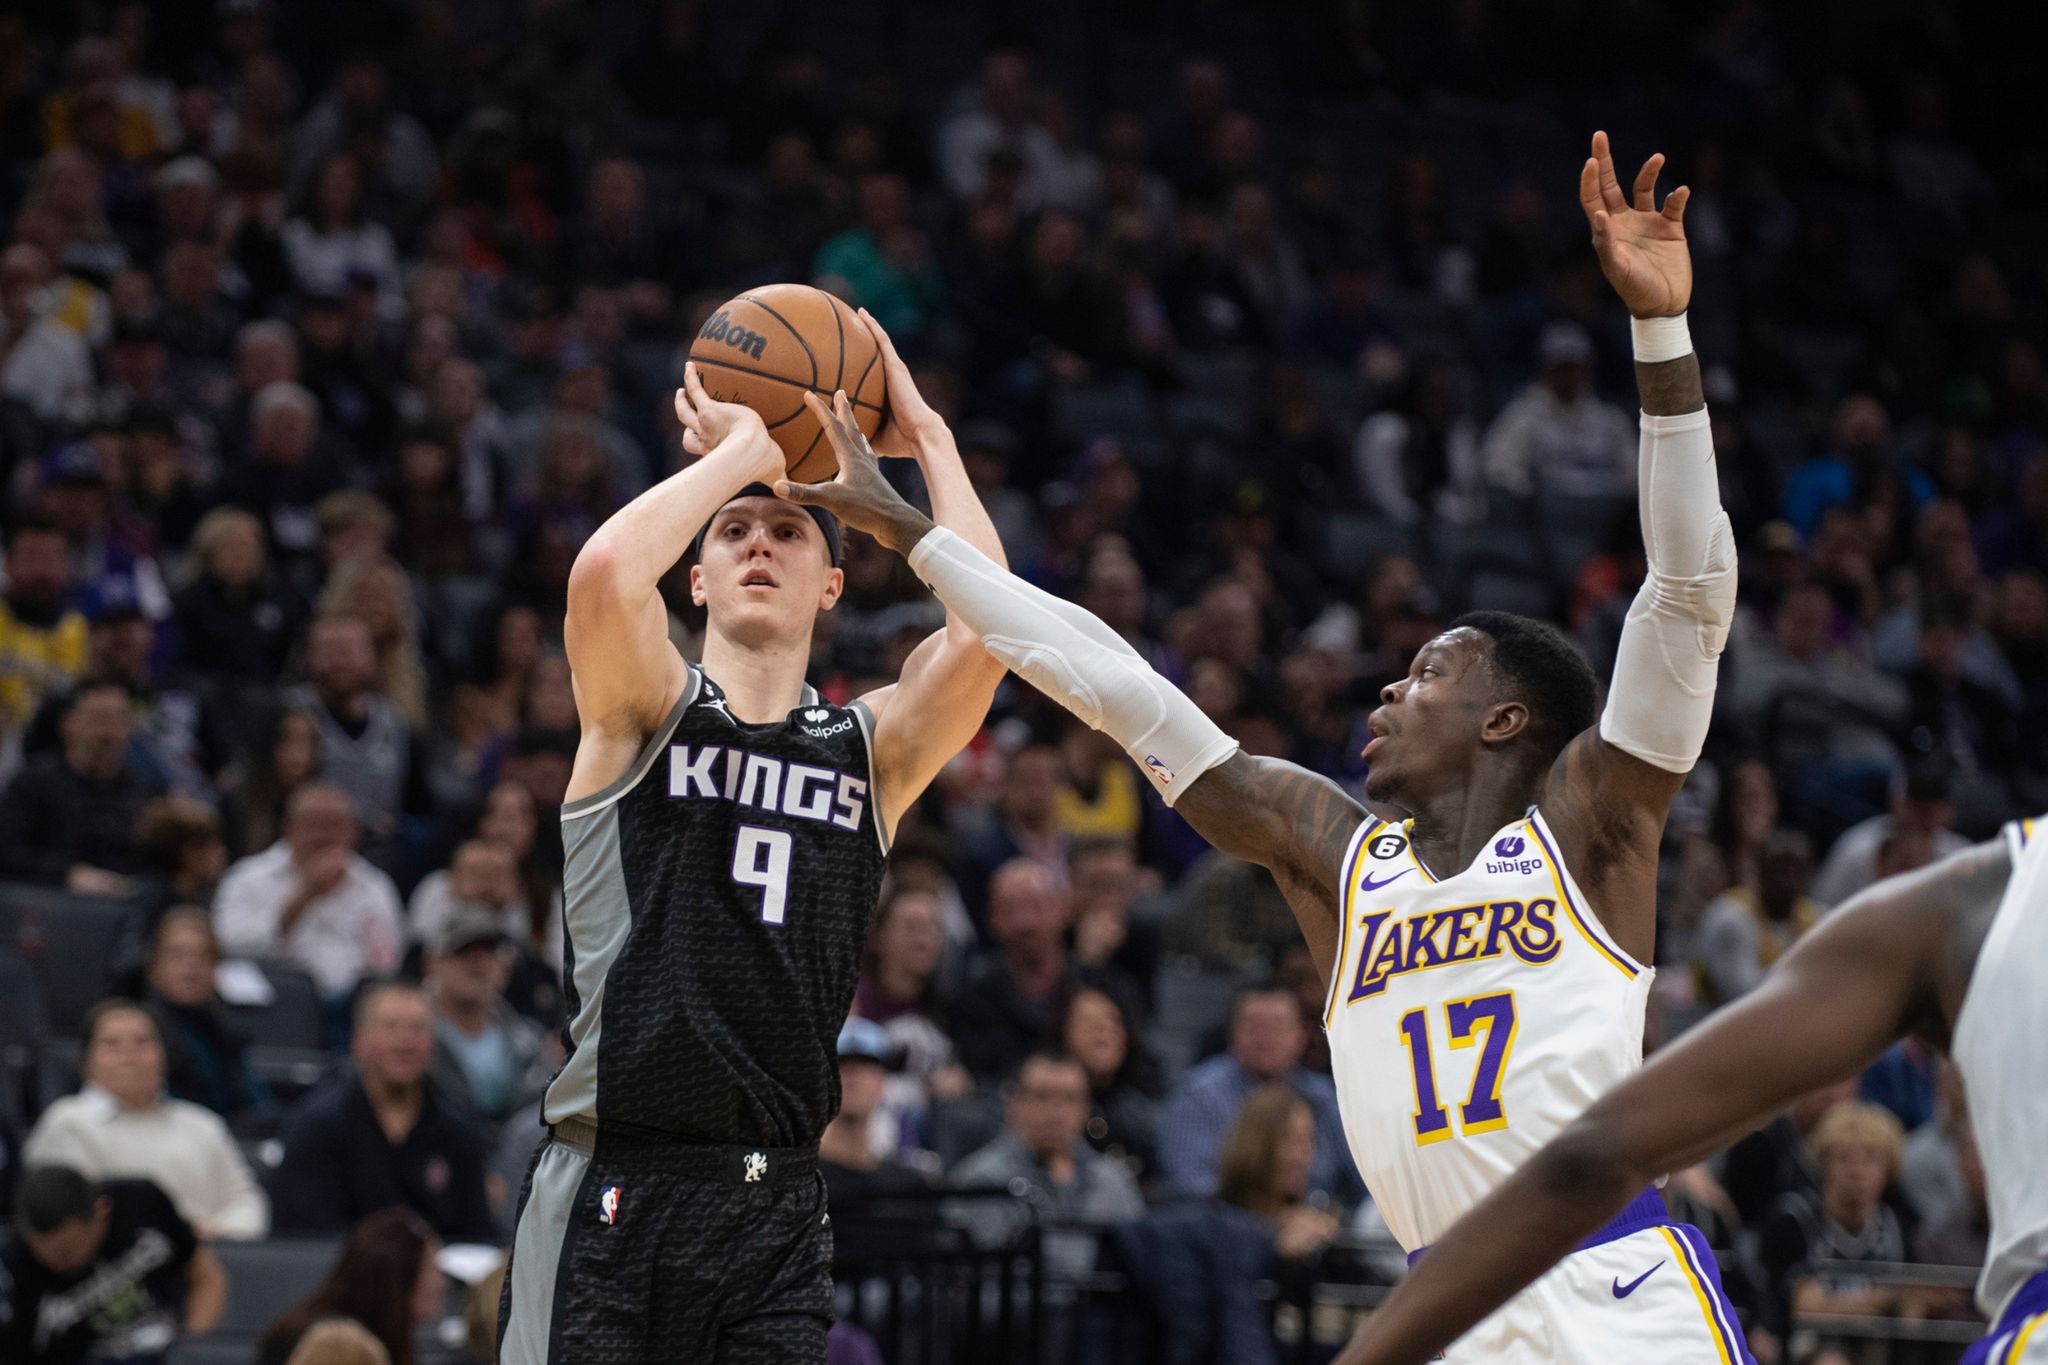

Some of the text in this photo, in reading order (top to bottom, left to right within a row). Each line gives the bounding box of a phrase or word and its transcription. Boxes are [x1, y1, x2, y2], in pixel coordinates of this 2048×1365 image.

[669, 744, 867, 831] KINGS
[730, 823, 794, 926] 9
[1375, 836, 1400, 858] 6
[1485, 858, 1543, 875] bibigo
[1347, 898, 1563, 1006] LAKERS
[1397, 989, 1519, 1147] 17
